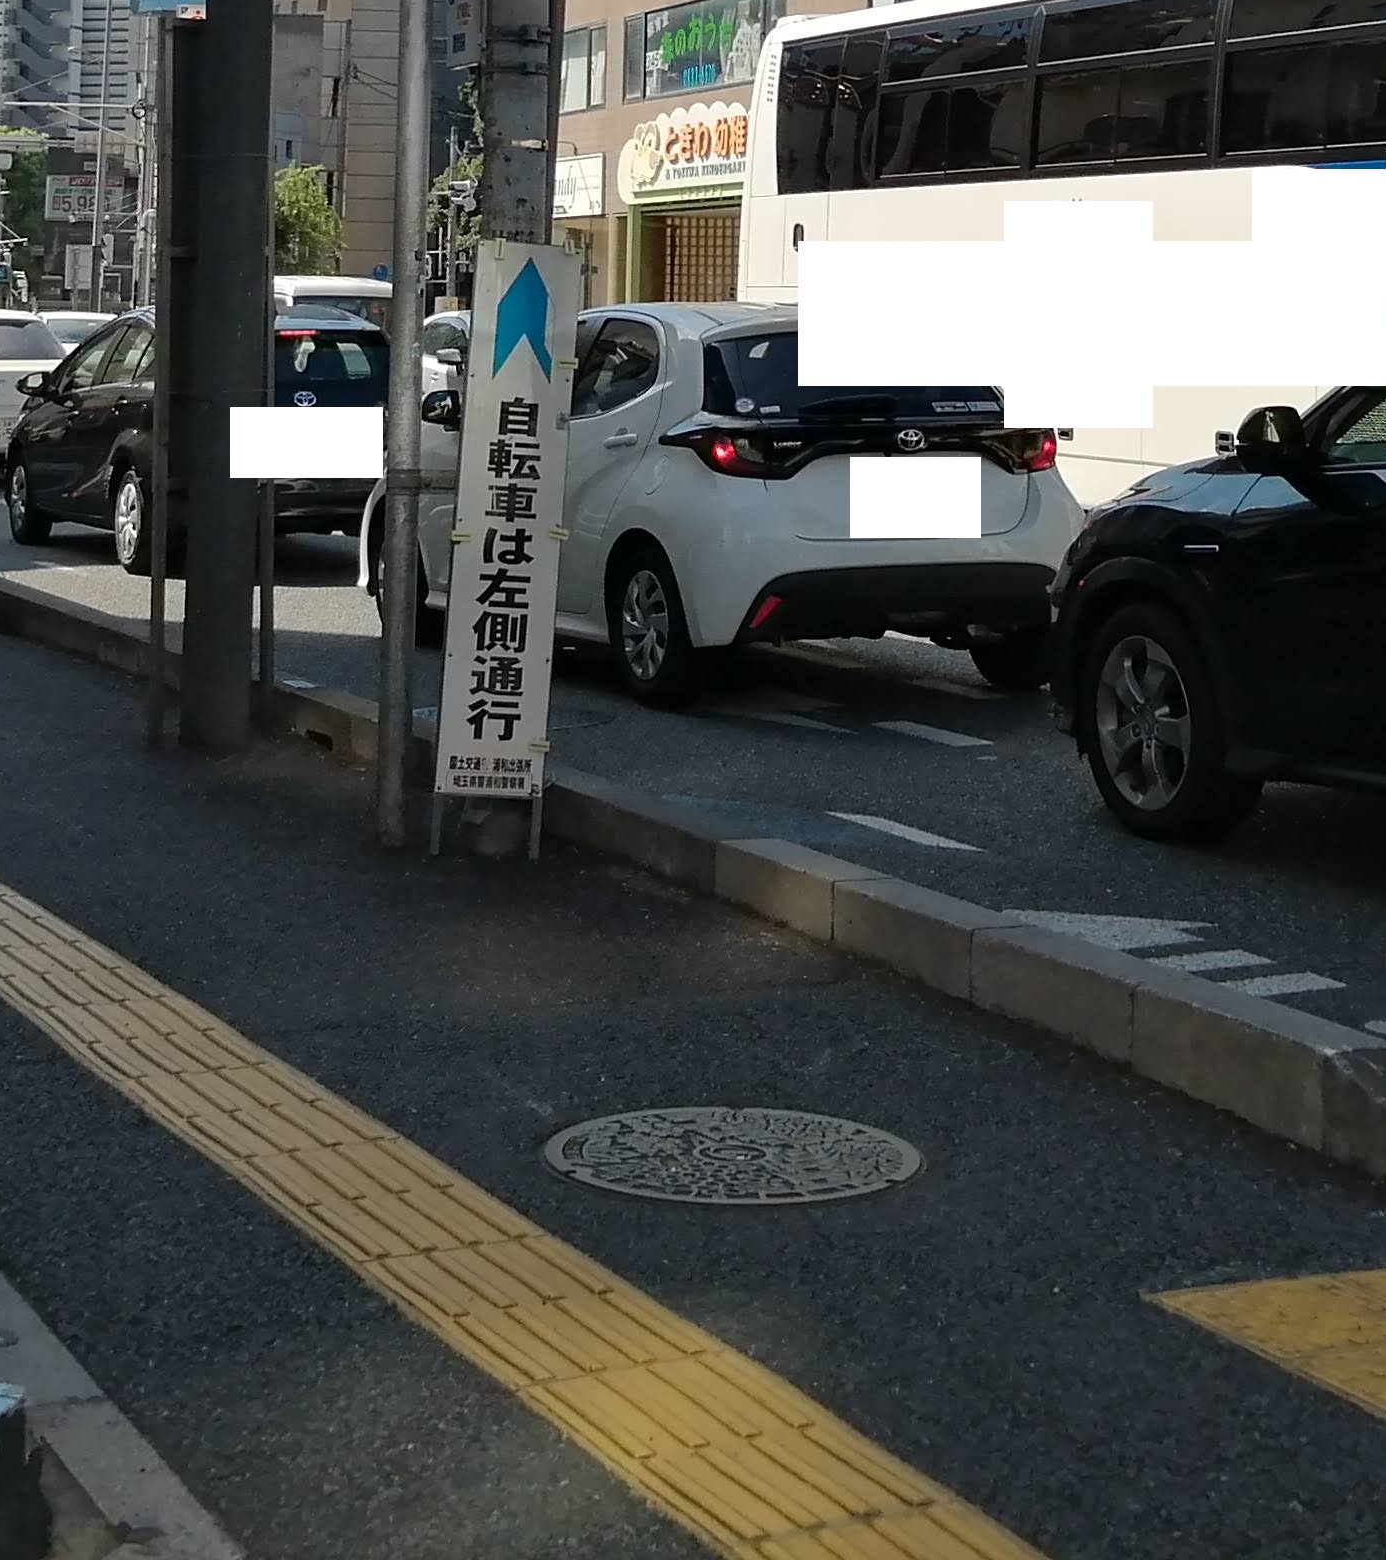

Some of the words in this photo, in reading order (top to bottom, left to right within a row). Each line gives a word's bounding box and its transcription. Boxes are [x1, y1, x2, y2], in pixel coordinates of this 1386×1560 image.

[664, 115, 749, 165] ときわ幼稚
[467, 396, 542, 742] 自転車は左側通行
